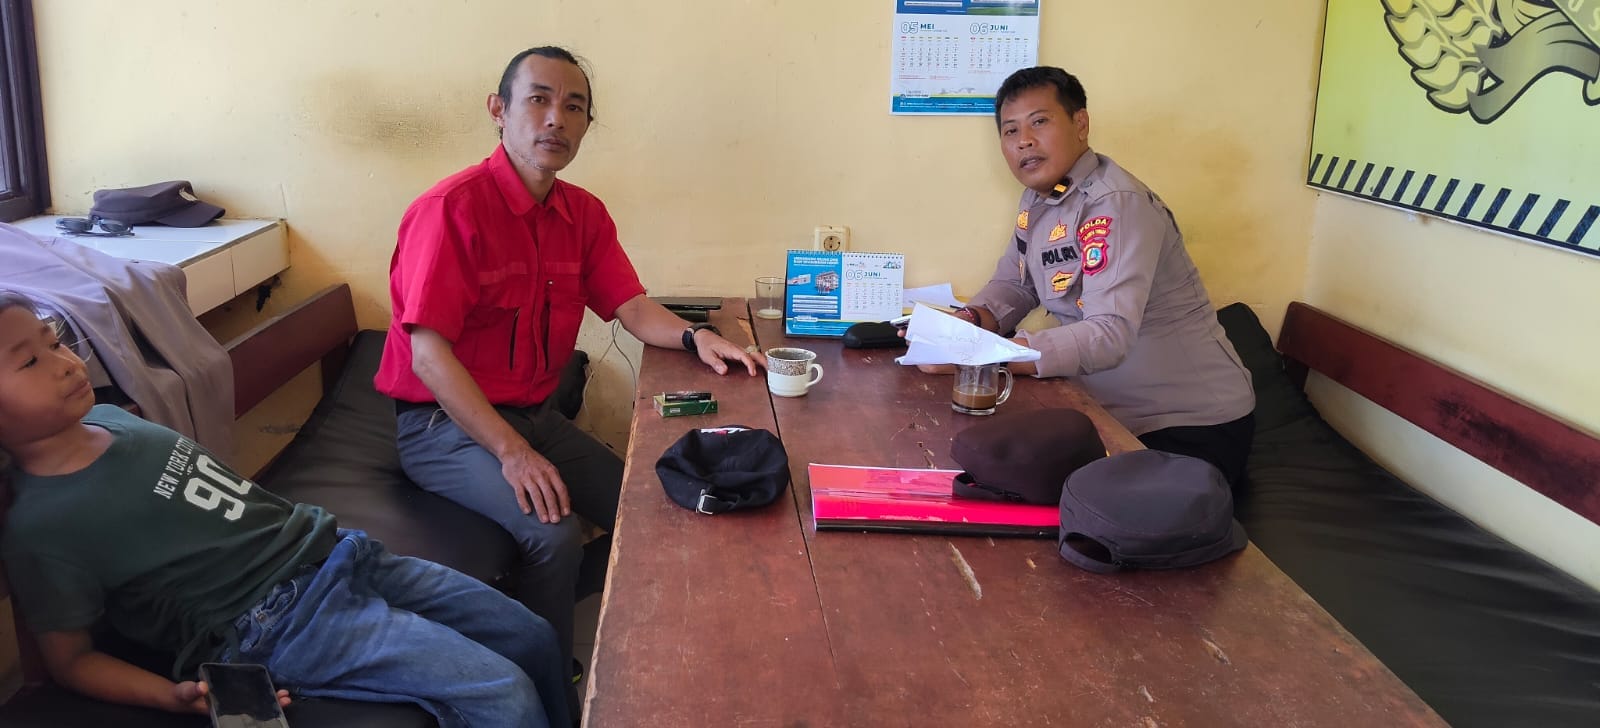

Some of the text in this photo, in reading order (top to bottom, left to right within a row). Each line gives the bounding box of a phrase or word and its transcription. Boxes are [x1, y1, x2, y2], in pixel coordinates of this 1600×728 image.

[900, 22, 919, 34] 05
[969, 23, 989, 35] 06
[1079, 218, 1108, 233] POLDA
[1041, 245, 1078, 267] POLRI
[846, 270, 863, 280] 06
[165, 449, 189, 476] YORK
[153, 472, 180, 500] NEW
[183, 454, 253, 521] 90
